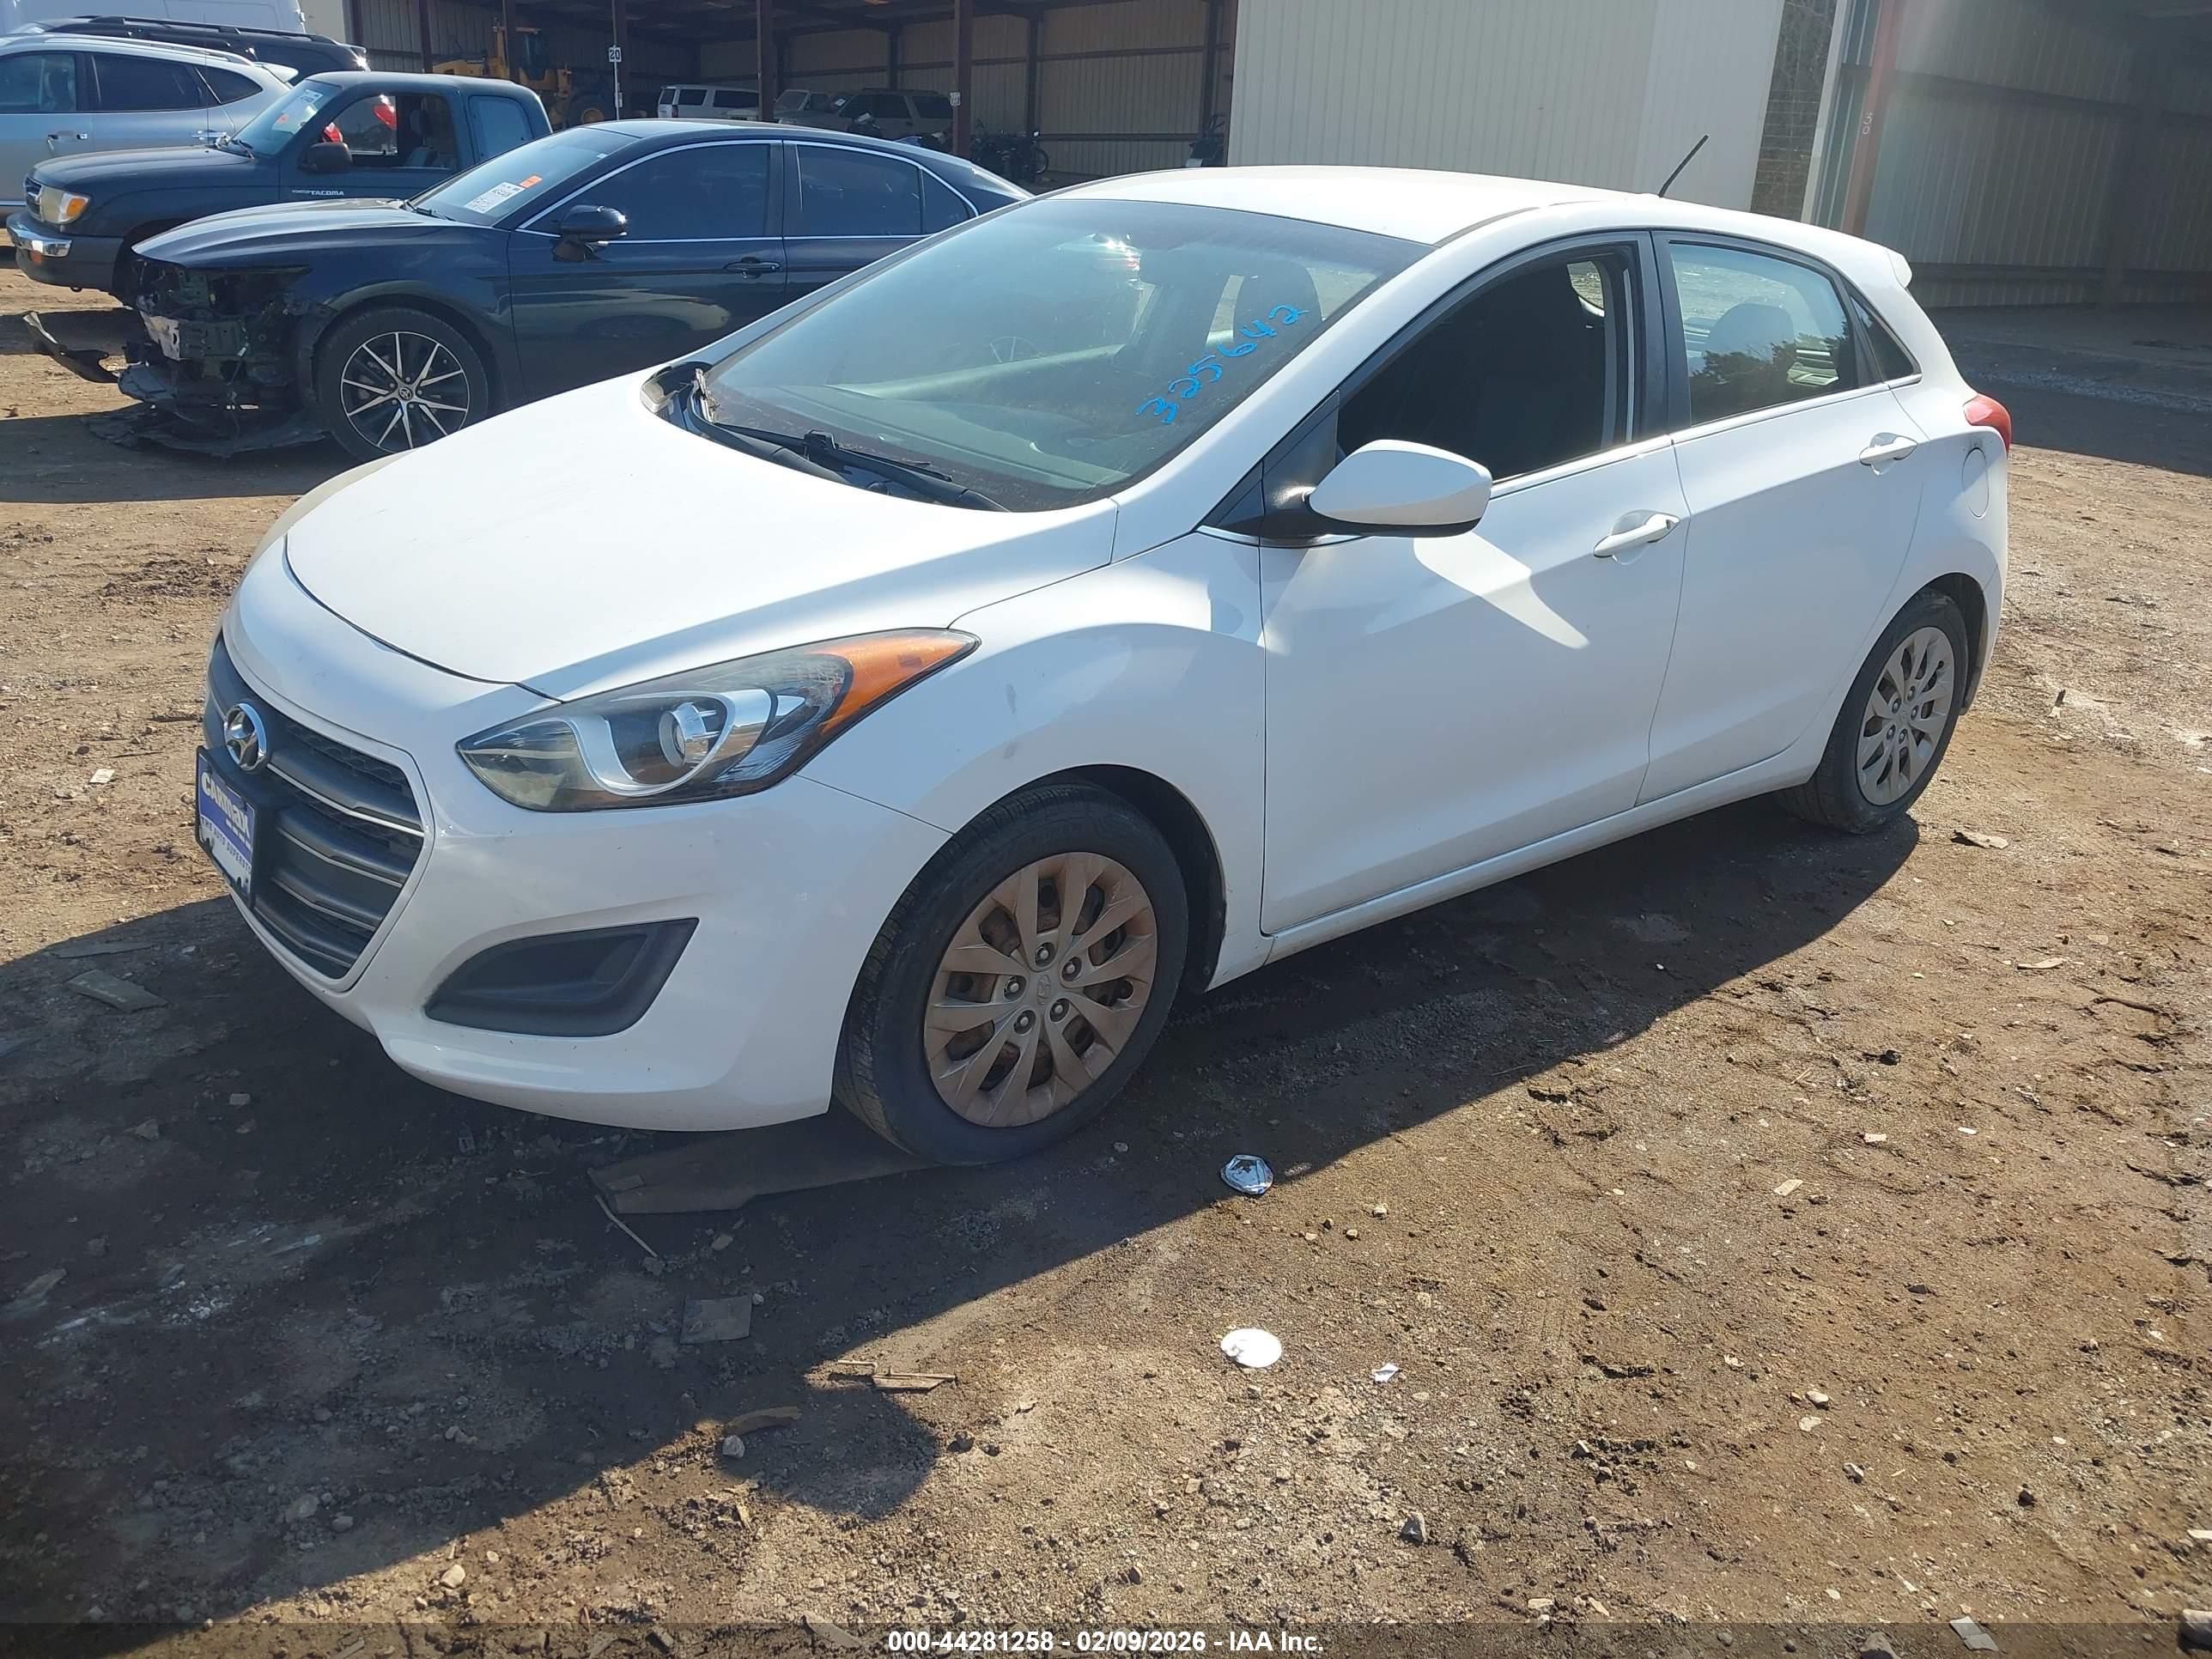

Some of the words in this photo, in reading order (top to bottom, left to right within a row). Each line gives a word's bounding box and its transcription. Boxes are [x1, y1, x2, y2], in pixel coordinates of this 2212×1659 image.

[610, 49, 621, 60] 20
[1134, 304, 1310, 424] 325642
[201, 817, 213, 833] THE
[213, 830, 227, 846] AUTO
